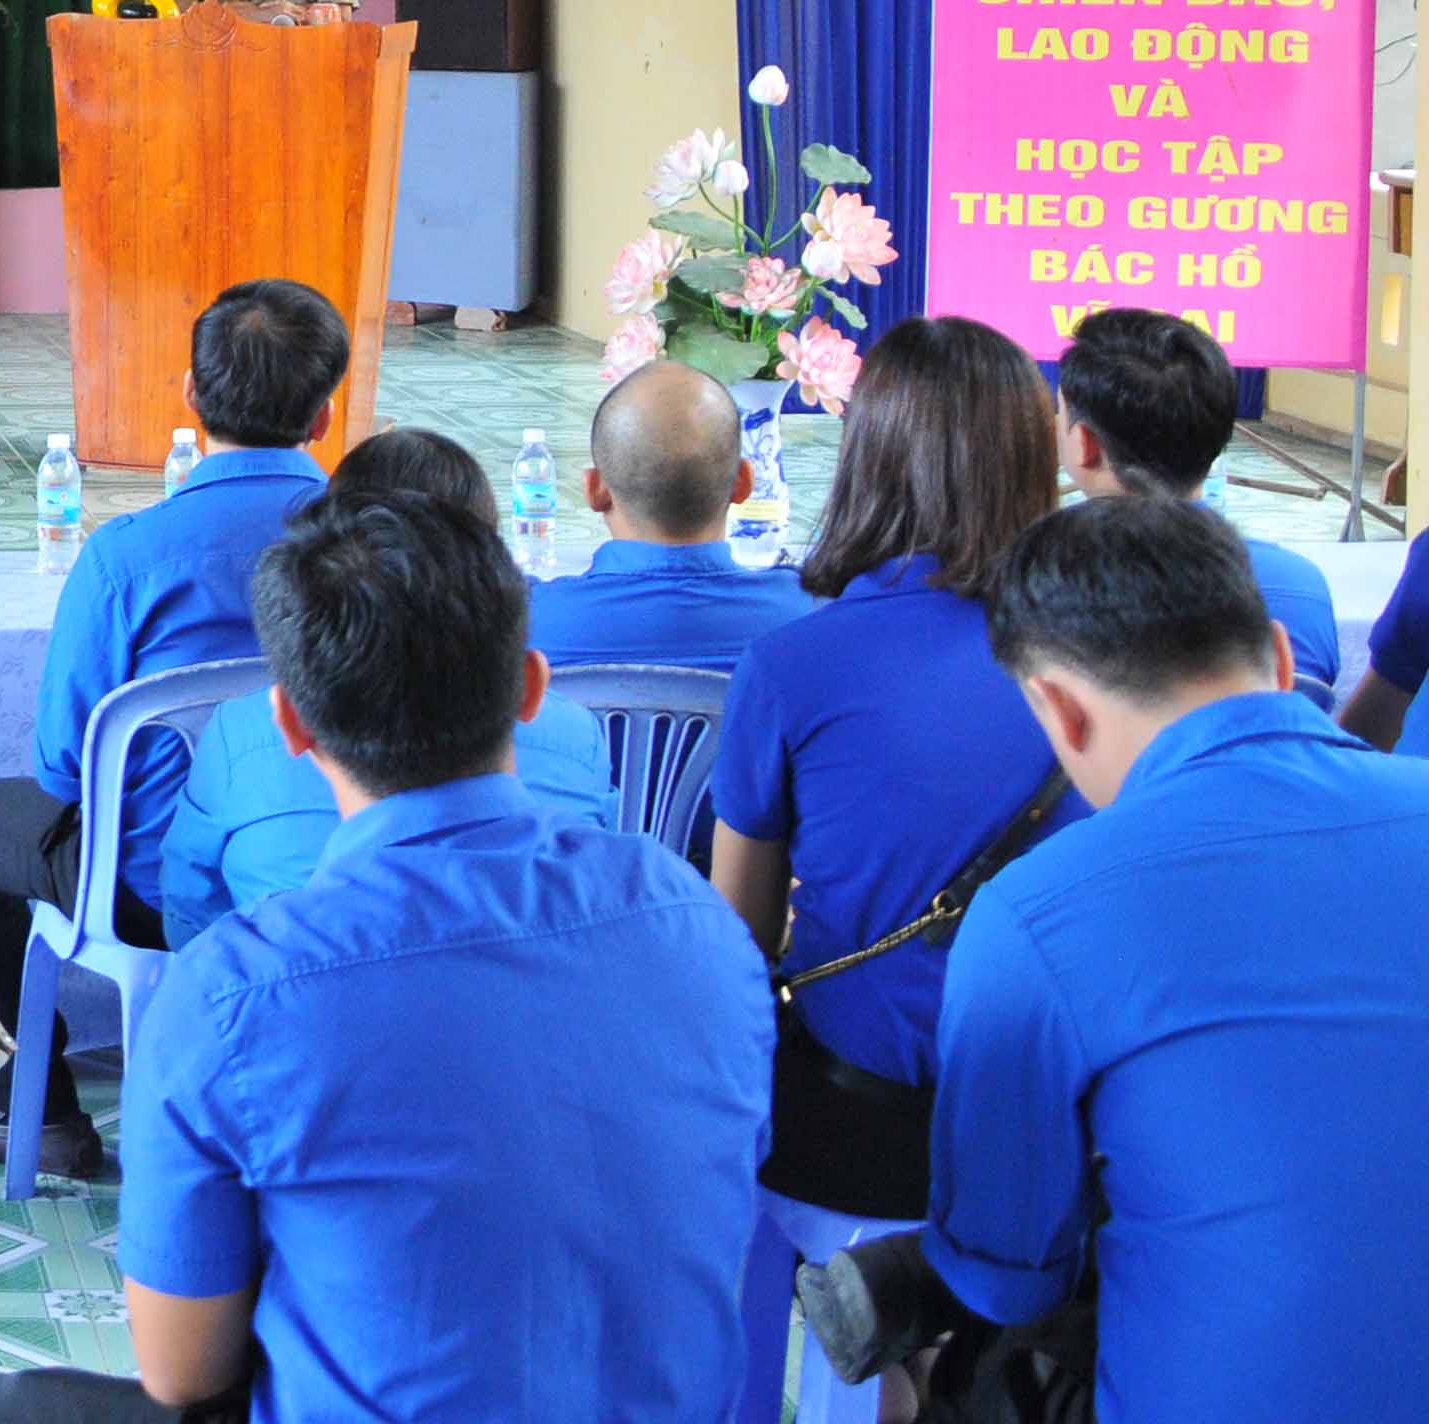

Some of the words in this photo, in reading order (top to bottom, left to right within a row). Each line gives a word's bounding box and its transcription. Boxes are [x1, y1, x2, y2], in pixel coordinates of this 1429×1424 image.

[997, 28, 1109, 61] LAO
[1131, 23, 1309, 69] ĐỘNG
[1109, 79, 1189, 117] VÀ
[1017, 139, 1140, 178] HỌC
[1163, 136, 1283, 182] TẬP
[950, 192, 1104, 227] THEO
[1128, 195, 1347, 233] GƯƠNG
[1030, 245, 1154, 285] BÁC
[1178, 244, 1261, 288] HỒ
